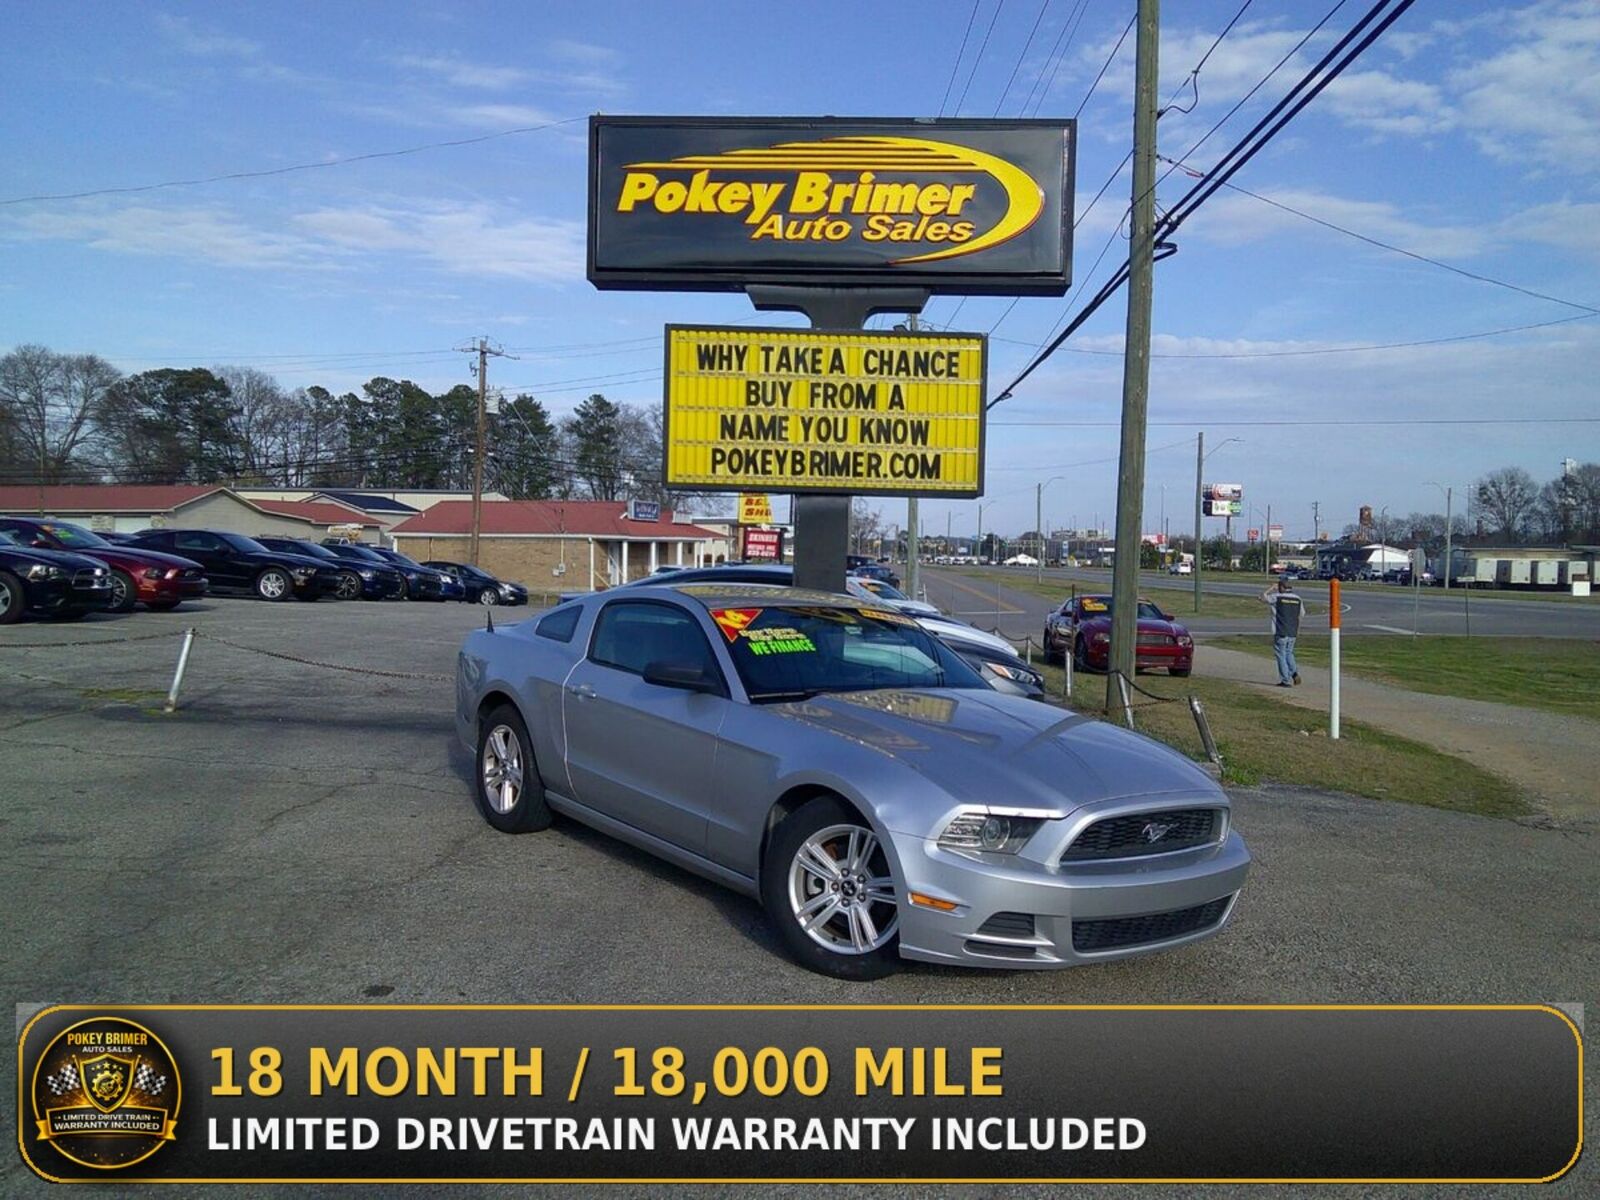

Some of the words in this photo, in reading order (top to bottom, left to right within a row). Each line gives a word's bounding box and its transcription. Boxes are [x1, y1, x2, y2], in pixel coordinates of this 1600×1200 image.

[617, 170, 786, 224] Pokey
[792, 171, 976, 216] Brimer
[751, 215, 853, 241] Auto
[862, 215, 977, 243] Sales
[697, 344, 748, 372] WHY
[761, 346, 823, 375] TAKE
[828, 347, 846, 375] A
[863, 349, 960, 378] CHANCE
[745, 380, 792, 408] BUY
[810, 382, 877, 410] FROM
[888, 383, 905, 411] A
[720, 414, 789, 442] NAME
[800, 416, 848, 444] YOU
[859, 418, 930, 447] KNOW
[711, 447, 941, 480] POKEYBRIMER.COM
[748, 641, 770, 655] WE
[768, 638, 817, 654] FINANCE
